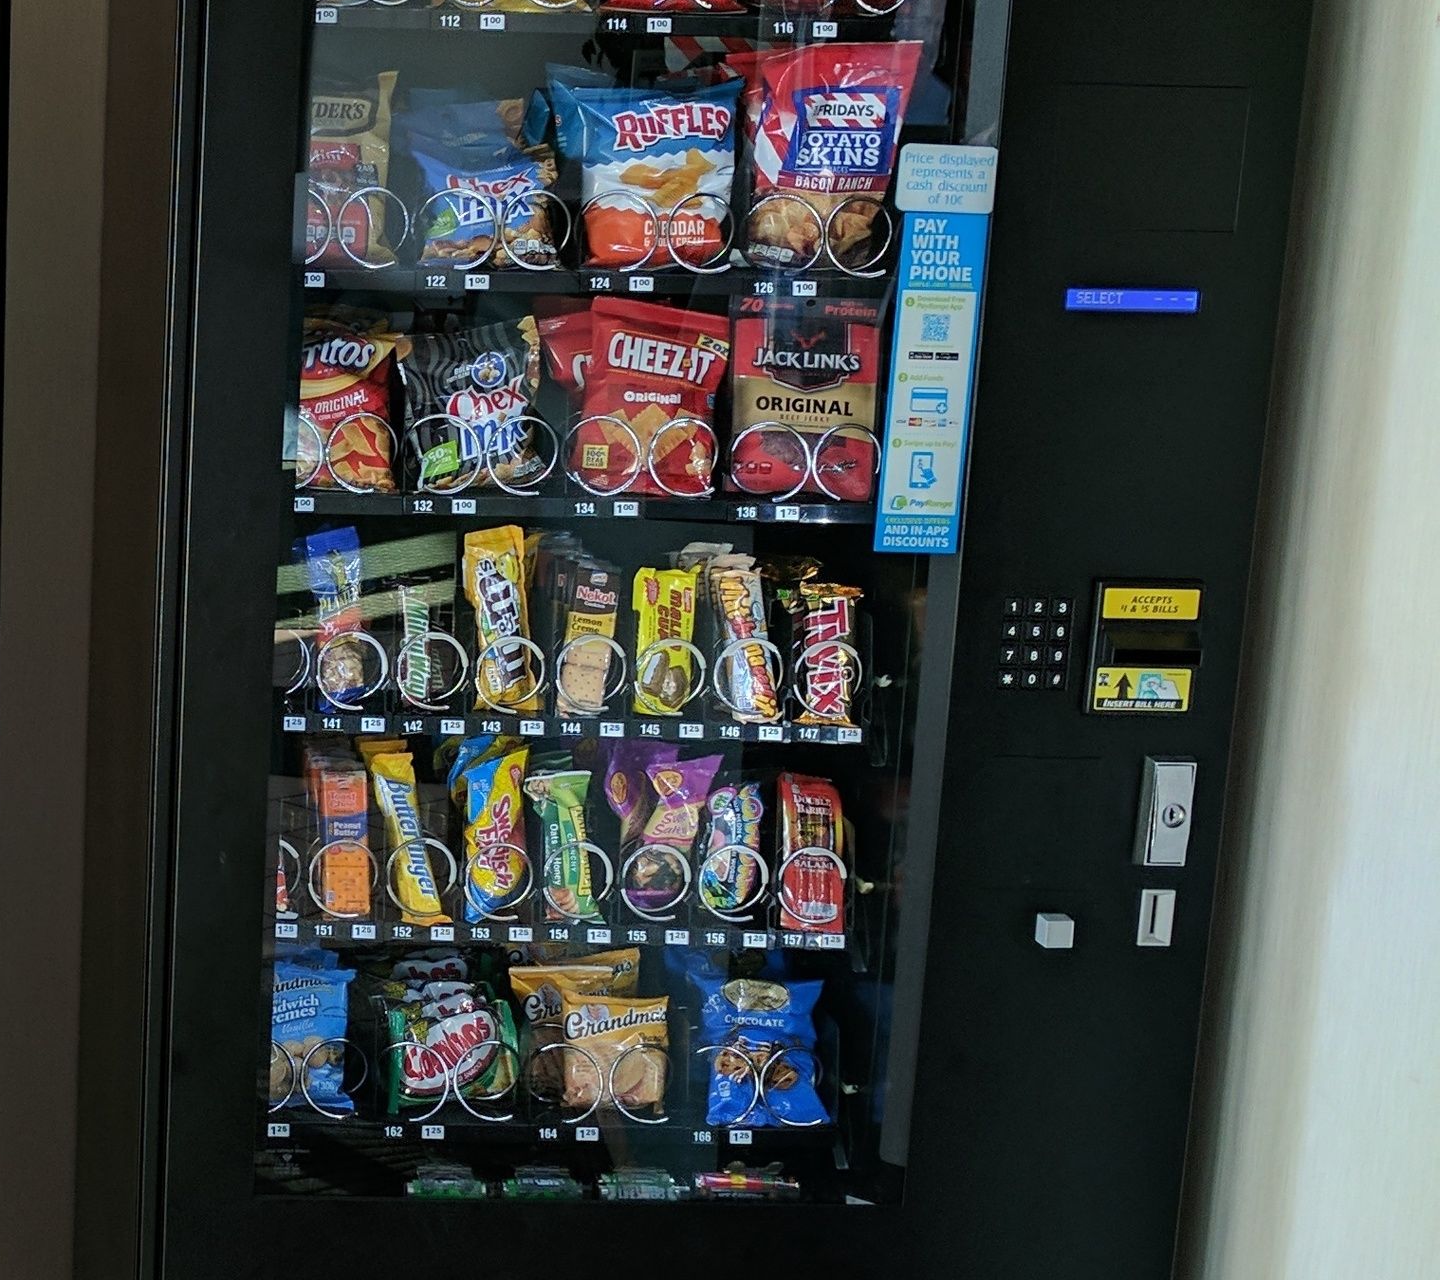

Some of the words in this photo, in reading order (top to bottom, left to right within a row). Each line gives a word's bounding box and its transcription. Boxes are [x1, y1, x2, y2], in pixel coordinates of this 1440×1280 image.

[440, 16, 460, 26] 112
[607, 19, 627, 30] 114
[773, 22, 794, 33] 116
[817, 103, 874, 118] FRIDAYS
[614, 104, 730, 151] RUFFLES
[802, 133, 881, 148] POTATO
[796, 148, 880, 168] SKINS
[905, 152, 934, 164] Price
[940, 153, 994, 167] displayed
[911, 169, 973, 180] represents
[977, 171, 985, 179] a
[794, 177, 835, 192] BACON
[837, 177, 872, 191] RANCH
[906, 180, 933, 190] cash
[938, 181, 988, 193] discount
[928, 194, 941, 204] of
[914, 219, 947, 233] PAY
[912, 234, 959, 250] WITH
[911, 250, 959, 265] YOUR
[910, 266, 972, 282] PHONE
[426, 276, 446, 287] 122
[590, 277, 610, 288] 124
[754, 283, 774, 294] 126
[1076, 292, 1123, 304] SELECT
[825, 305, 877, 317] Protein
[753, 348, 802, 368] JACK
[803, 352, 860, 371] LINK'S
[315, 389, 369, 414] ORIGINAL
[448, 380, 526, 417] Chex
[756, 396, 853, 417] ORIGINAL
[414, 501, 433, 511] 132
[574, 503, 595, 514] 134
[737, 507, 756, 518] 136
[884, 525, 908, 535] AND
[910, 525, 949, 536] IN-APP
[883, 536, 949, 548] DISCOUNTS
[576, 586, 616, 604] Nekot
[1131, 596, 1173, 604] ACCEPTS
[1152, 605, 1180, 613] BILLS
[572, 615, 603, 627] Lemon
[571, 623, 600, 634] Creme
[1102, 699, 1134, 709] INSERT
[1134, 700, 1153, 709] BILL
[1154, 701, 1177, 709] HERE
[323, 719, 341, 729] 141
[404, 721, 423, 732] 142
[482, 722, 501, 732] 143
[561, 724, 581, 734] 144
[640, 724, 660, 735] 145
[720, 726, 740, 737] 146
[799, 728, 818, 739] 147
[549, 824, 559, 844] Oats
[314, 925, 333, 935] 151
[393, 927, 412, 937] 152
[470, 928, 490, 938] 153
[549, 929, 568, 940] 154
[627, 930, 647, 941] 155
[705, 933, 725, 943] 156
[782, 934, 802, 945] 157
[725, 1014, 785, 1027] CHOCOLATE
[385, 1126, 403, 1137] 162
[539, 1128, 557, 1139] 164
[693, 1131, 711, 1142] 166
